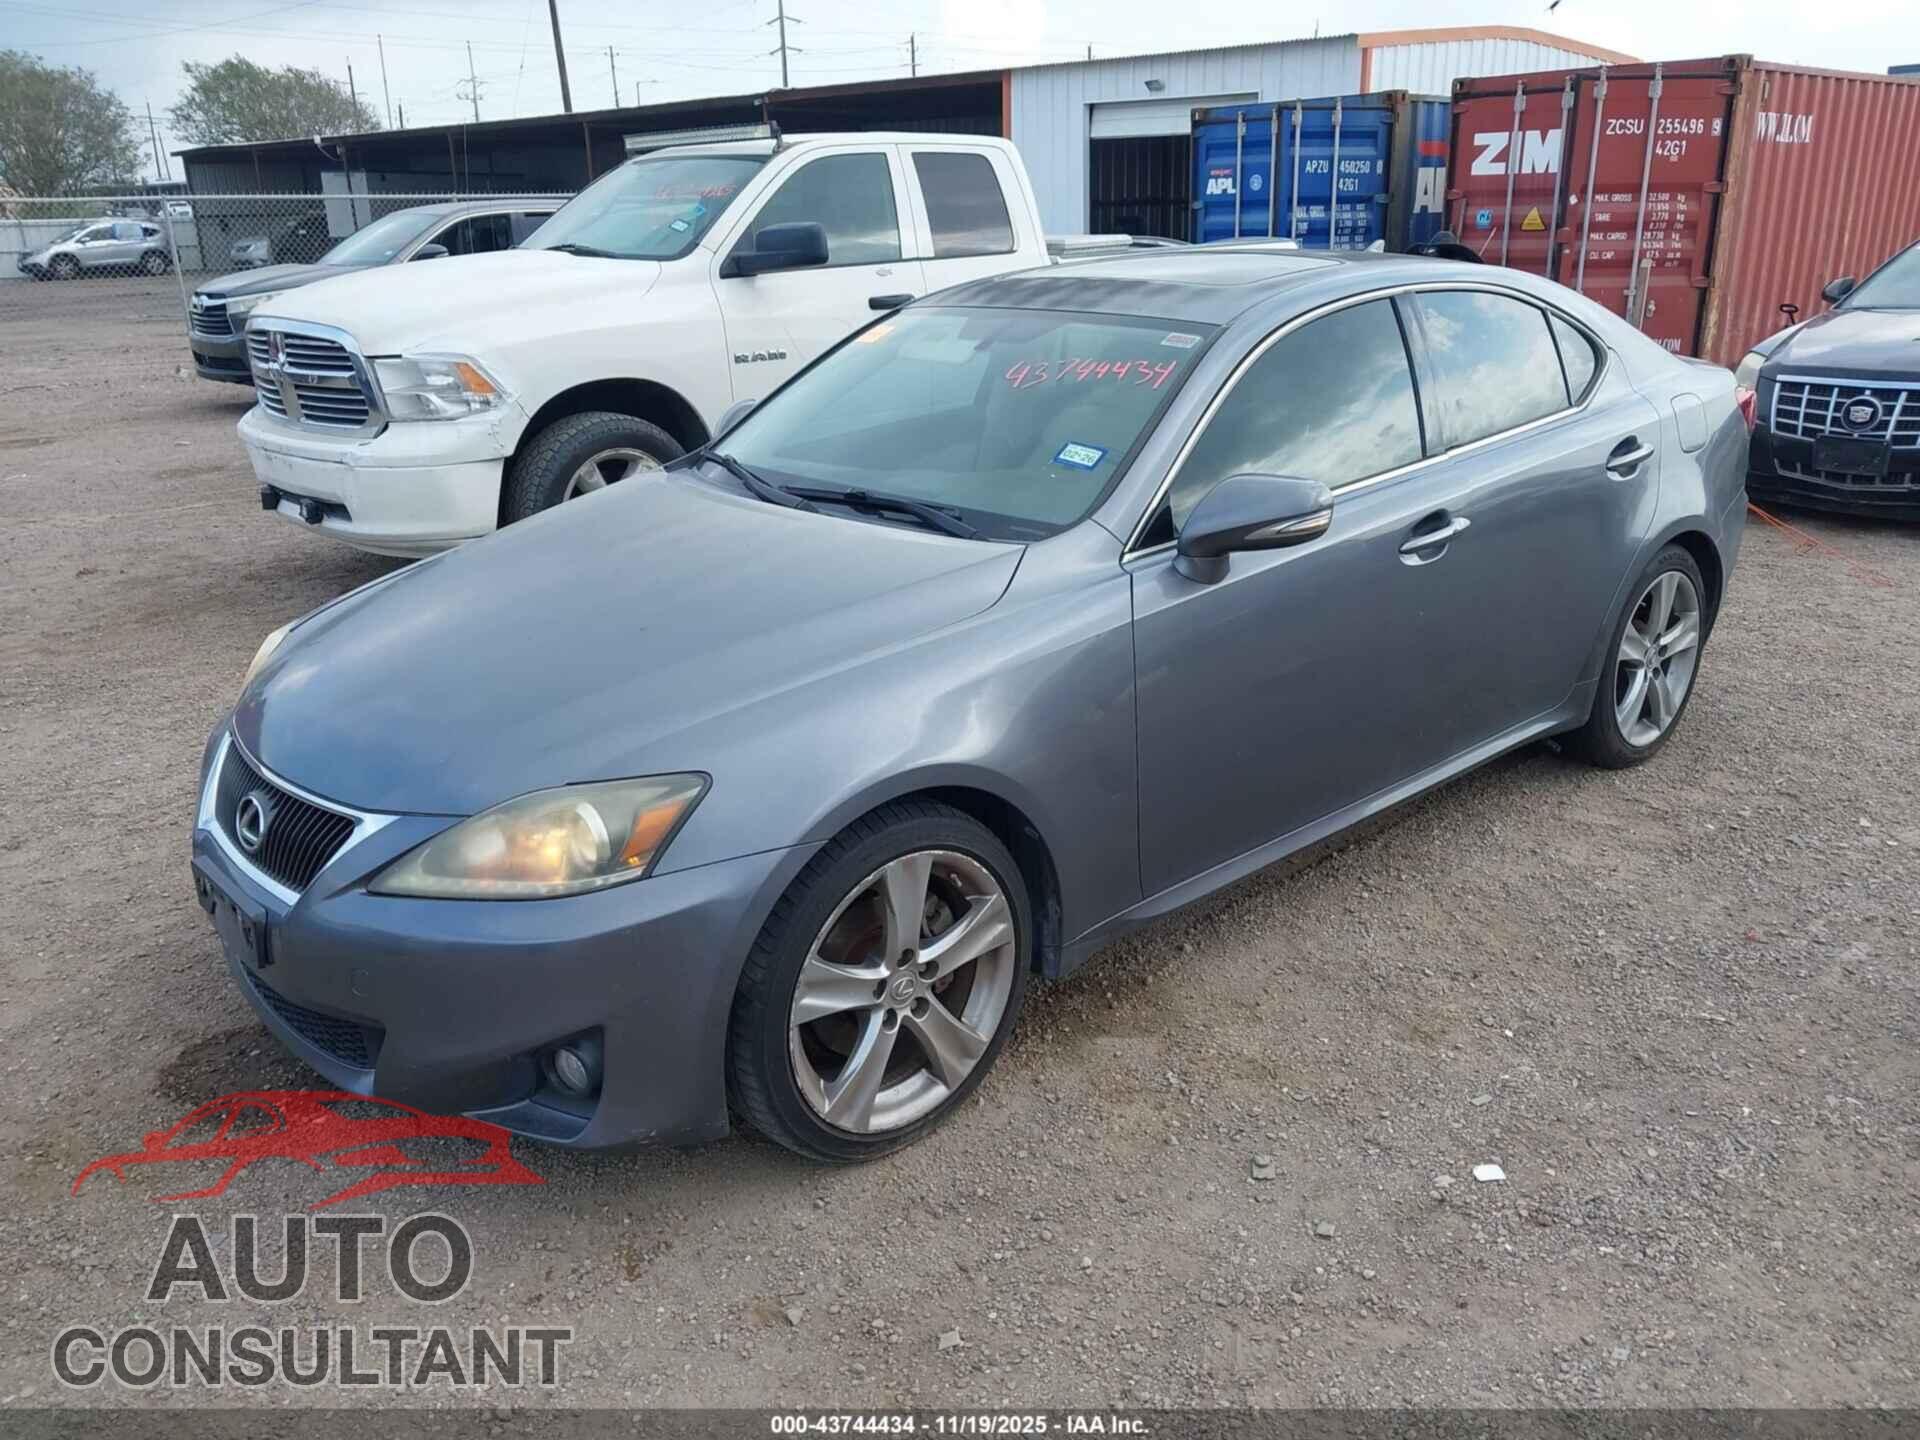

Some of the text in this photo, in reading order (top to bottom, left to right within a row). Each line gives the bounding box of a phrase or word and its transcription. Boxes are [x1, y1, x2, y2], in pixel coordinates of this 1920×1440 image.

[1606, 118, 1721, 136] ZCSU 255496 9
[1471, 128, 1562, 176] ZIM
[1656, 140, 1687, 156] 42G1
[1305, 160, 1329, 174] APZU
[1206, 178, 1236, 194] APL
